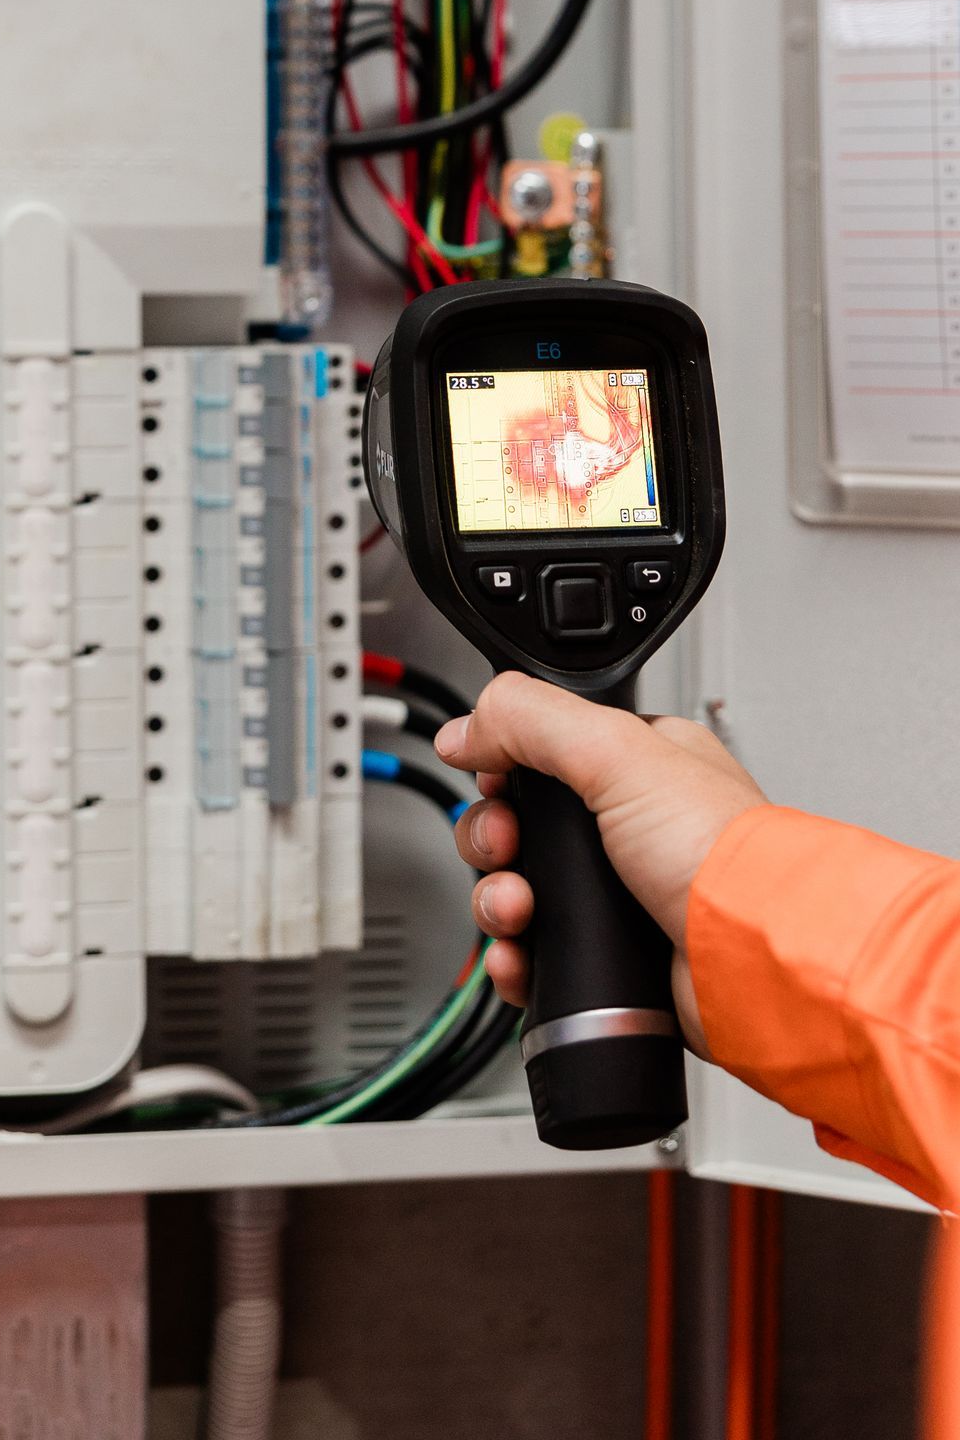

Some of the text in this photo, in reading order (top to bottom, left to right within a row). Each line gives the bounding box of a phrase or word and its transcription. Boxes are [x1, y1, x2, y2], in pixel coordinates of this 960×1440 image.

[536, 342, 561, 360] E6
[451, 377, 480, 389] 28.5
[622, 375, 643, 385] 29.3
[381, 448, 396, 482] FLIR
